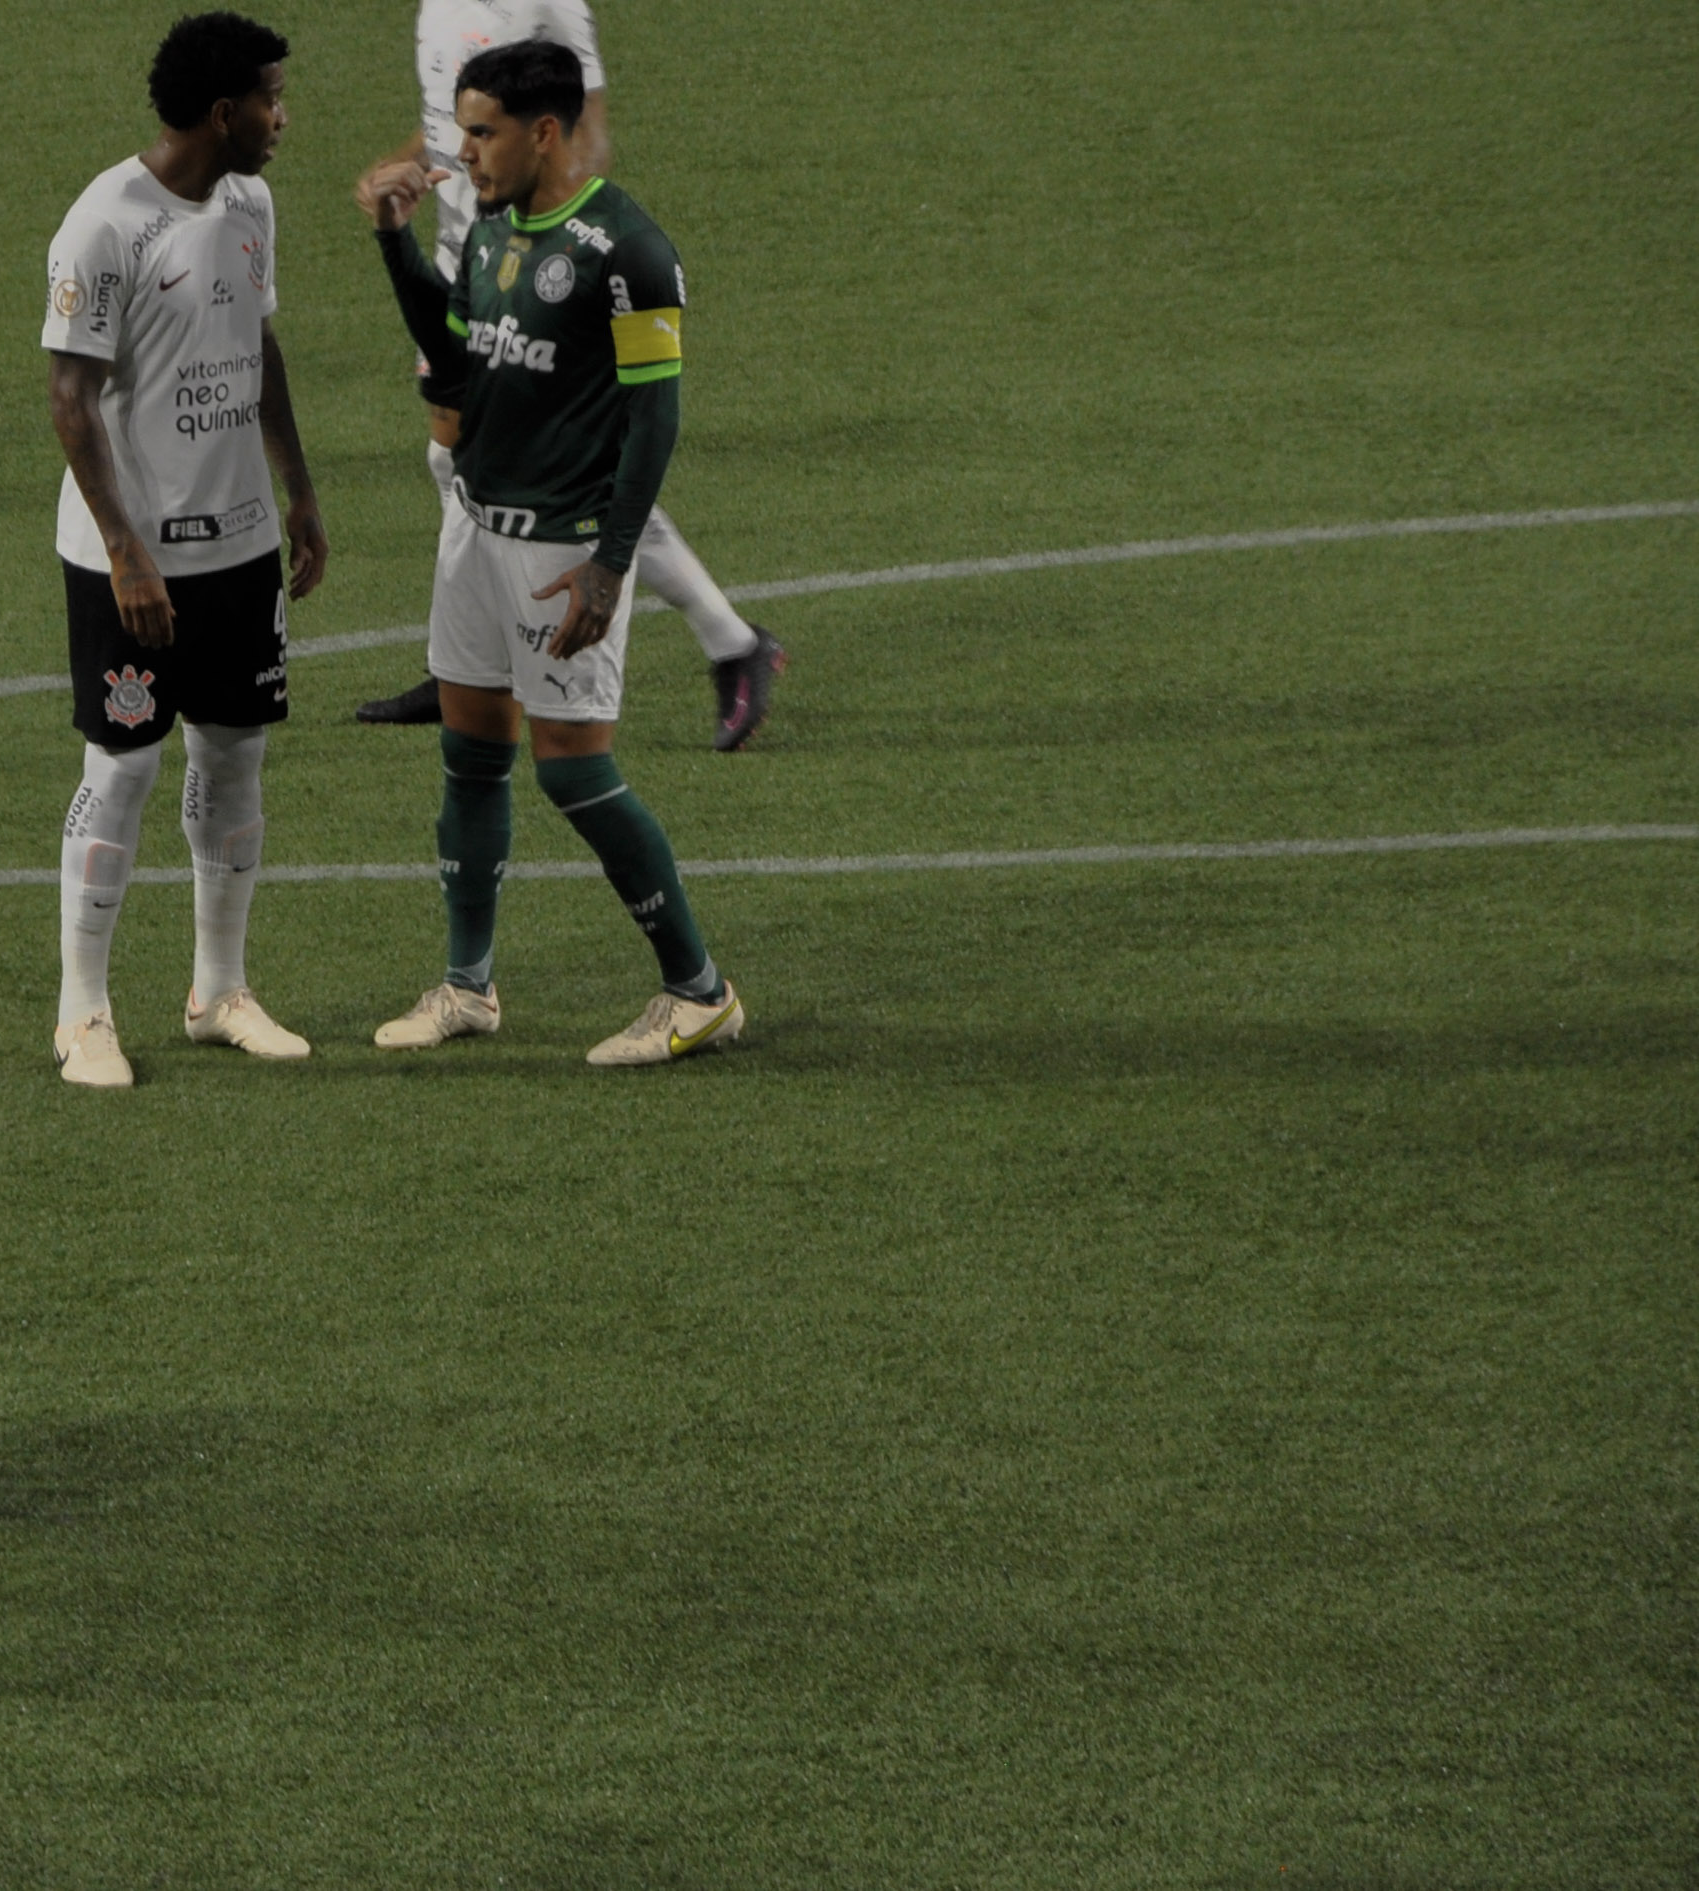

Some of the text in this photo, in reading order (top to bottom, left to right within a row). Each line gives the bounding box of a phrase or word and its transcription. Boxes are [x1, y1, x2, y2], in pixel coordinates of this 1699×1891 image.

[132, 208, 174, 260] pixbet
[564, 217, 614, 254] crefisa
[176, 382, 229, 407] neo
[169, 520, 211, 538] FIEL
